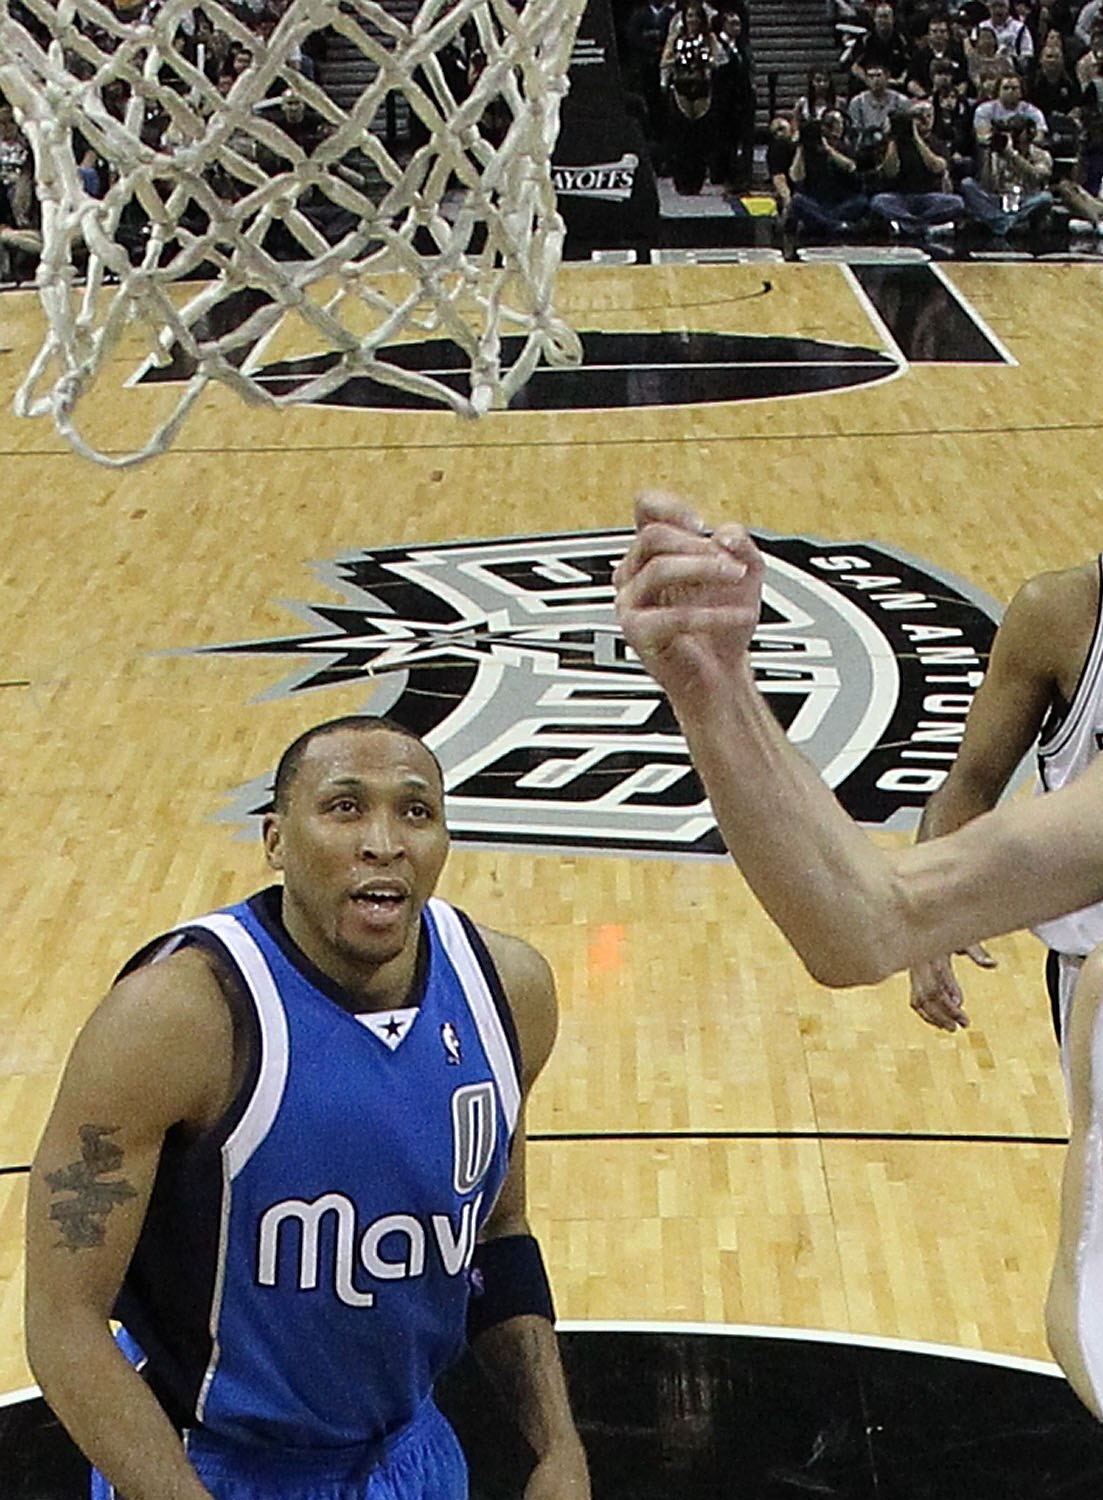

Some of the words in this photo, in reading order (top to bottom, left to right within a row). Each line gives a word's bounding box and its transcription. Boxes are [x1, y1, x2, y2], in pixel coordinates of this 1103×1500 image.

[809, 555, 938, 611] SAN
[874, 623, 986, 793] ANTONIO
[452, 1080, 497, 1195] 0
